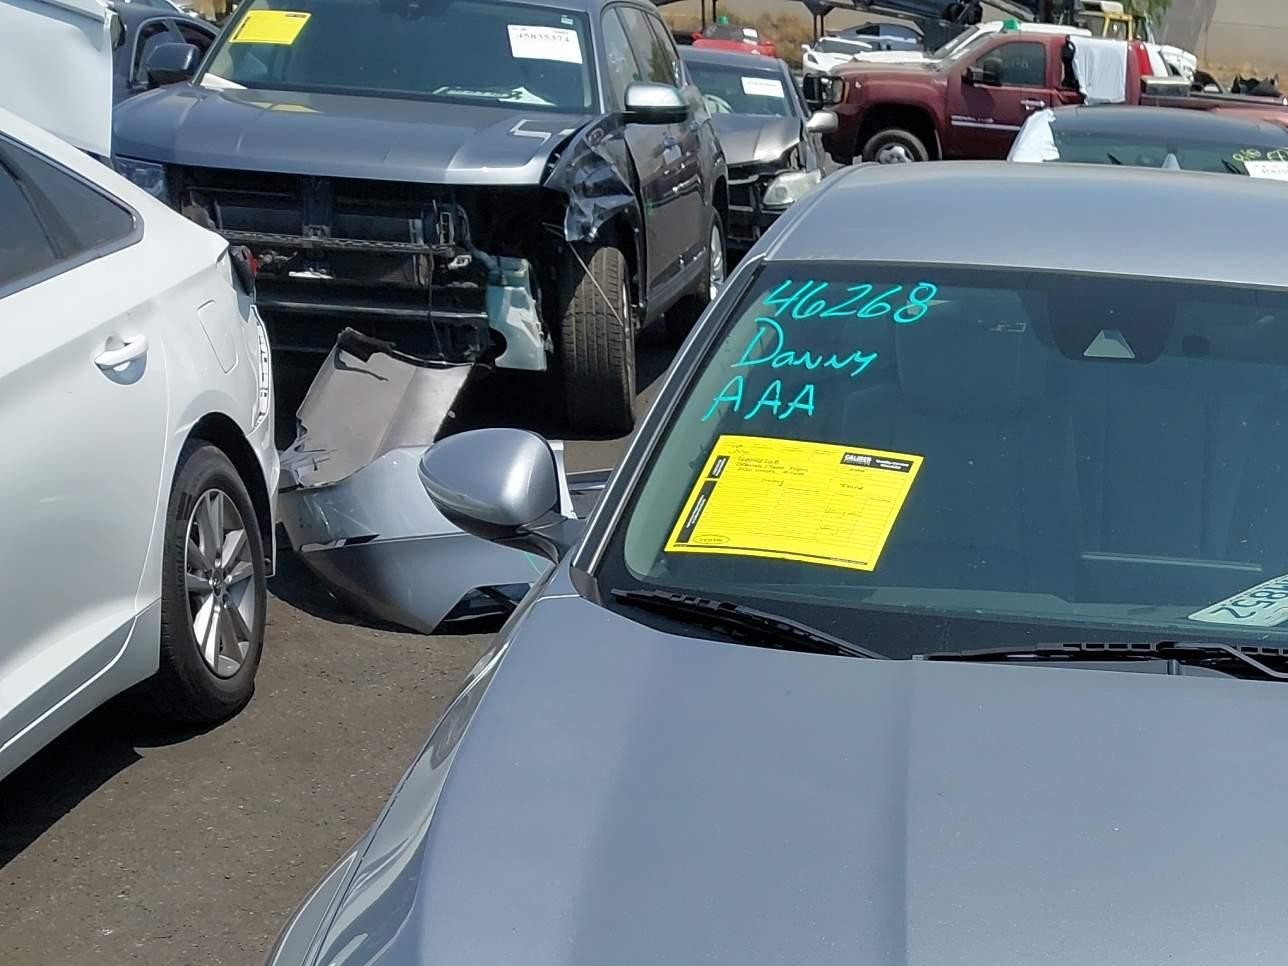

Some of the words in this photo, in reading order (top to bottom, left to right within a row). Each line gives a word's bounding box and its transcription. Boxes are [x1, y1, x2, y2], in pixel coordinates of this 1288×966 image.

[763, 280, 938, 323] 46268
[731, 317, 878, 377] Danny
[701, 375, 815, 422] AAA
